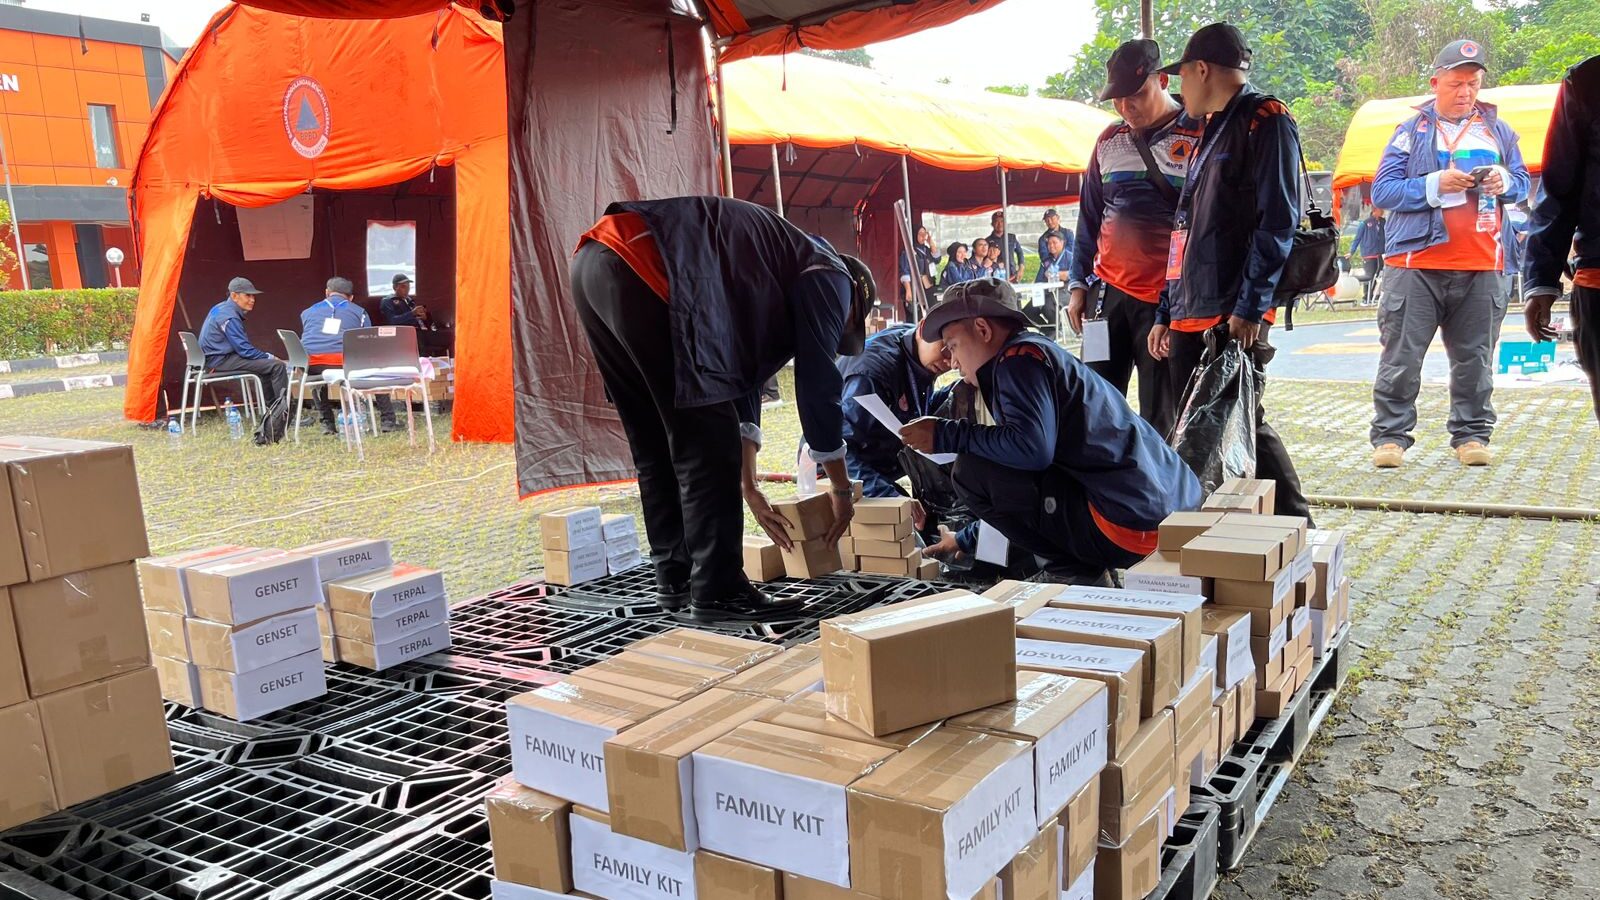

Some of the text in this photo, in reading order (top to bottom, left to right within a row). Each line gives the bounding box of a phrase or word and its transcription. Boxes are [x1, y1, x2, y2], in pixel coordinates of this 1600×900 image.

[337, 551, 373, 568] TERPAL
[255, 577, 299, 598] GENSET
[392, 585, 427, 603] TERPAL
[1082, 593, 1178, 607] KIDSWARE
[395, 609, 430, 628] TERPAL
[1048, 617, 1148, 633] KIDSWARE
[255, 624, 298, 646] GENSET
[399, 637, 432, 656] TERPAL
[1016, 649, 1113, 665] IDSWARE
[259, 671, 304, 694] GENSET
[525, 734, 604, 773] FAMILY KIT
[1049, 729, 1098, 785] FAMILY KIT
[715, 791, 825, 836] FAMILY KIT
[958, 787, 1022, 860] FAMILY KIT
[593, 852, 683, 897] FAMILY KIT
